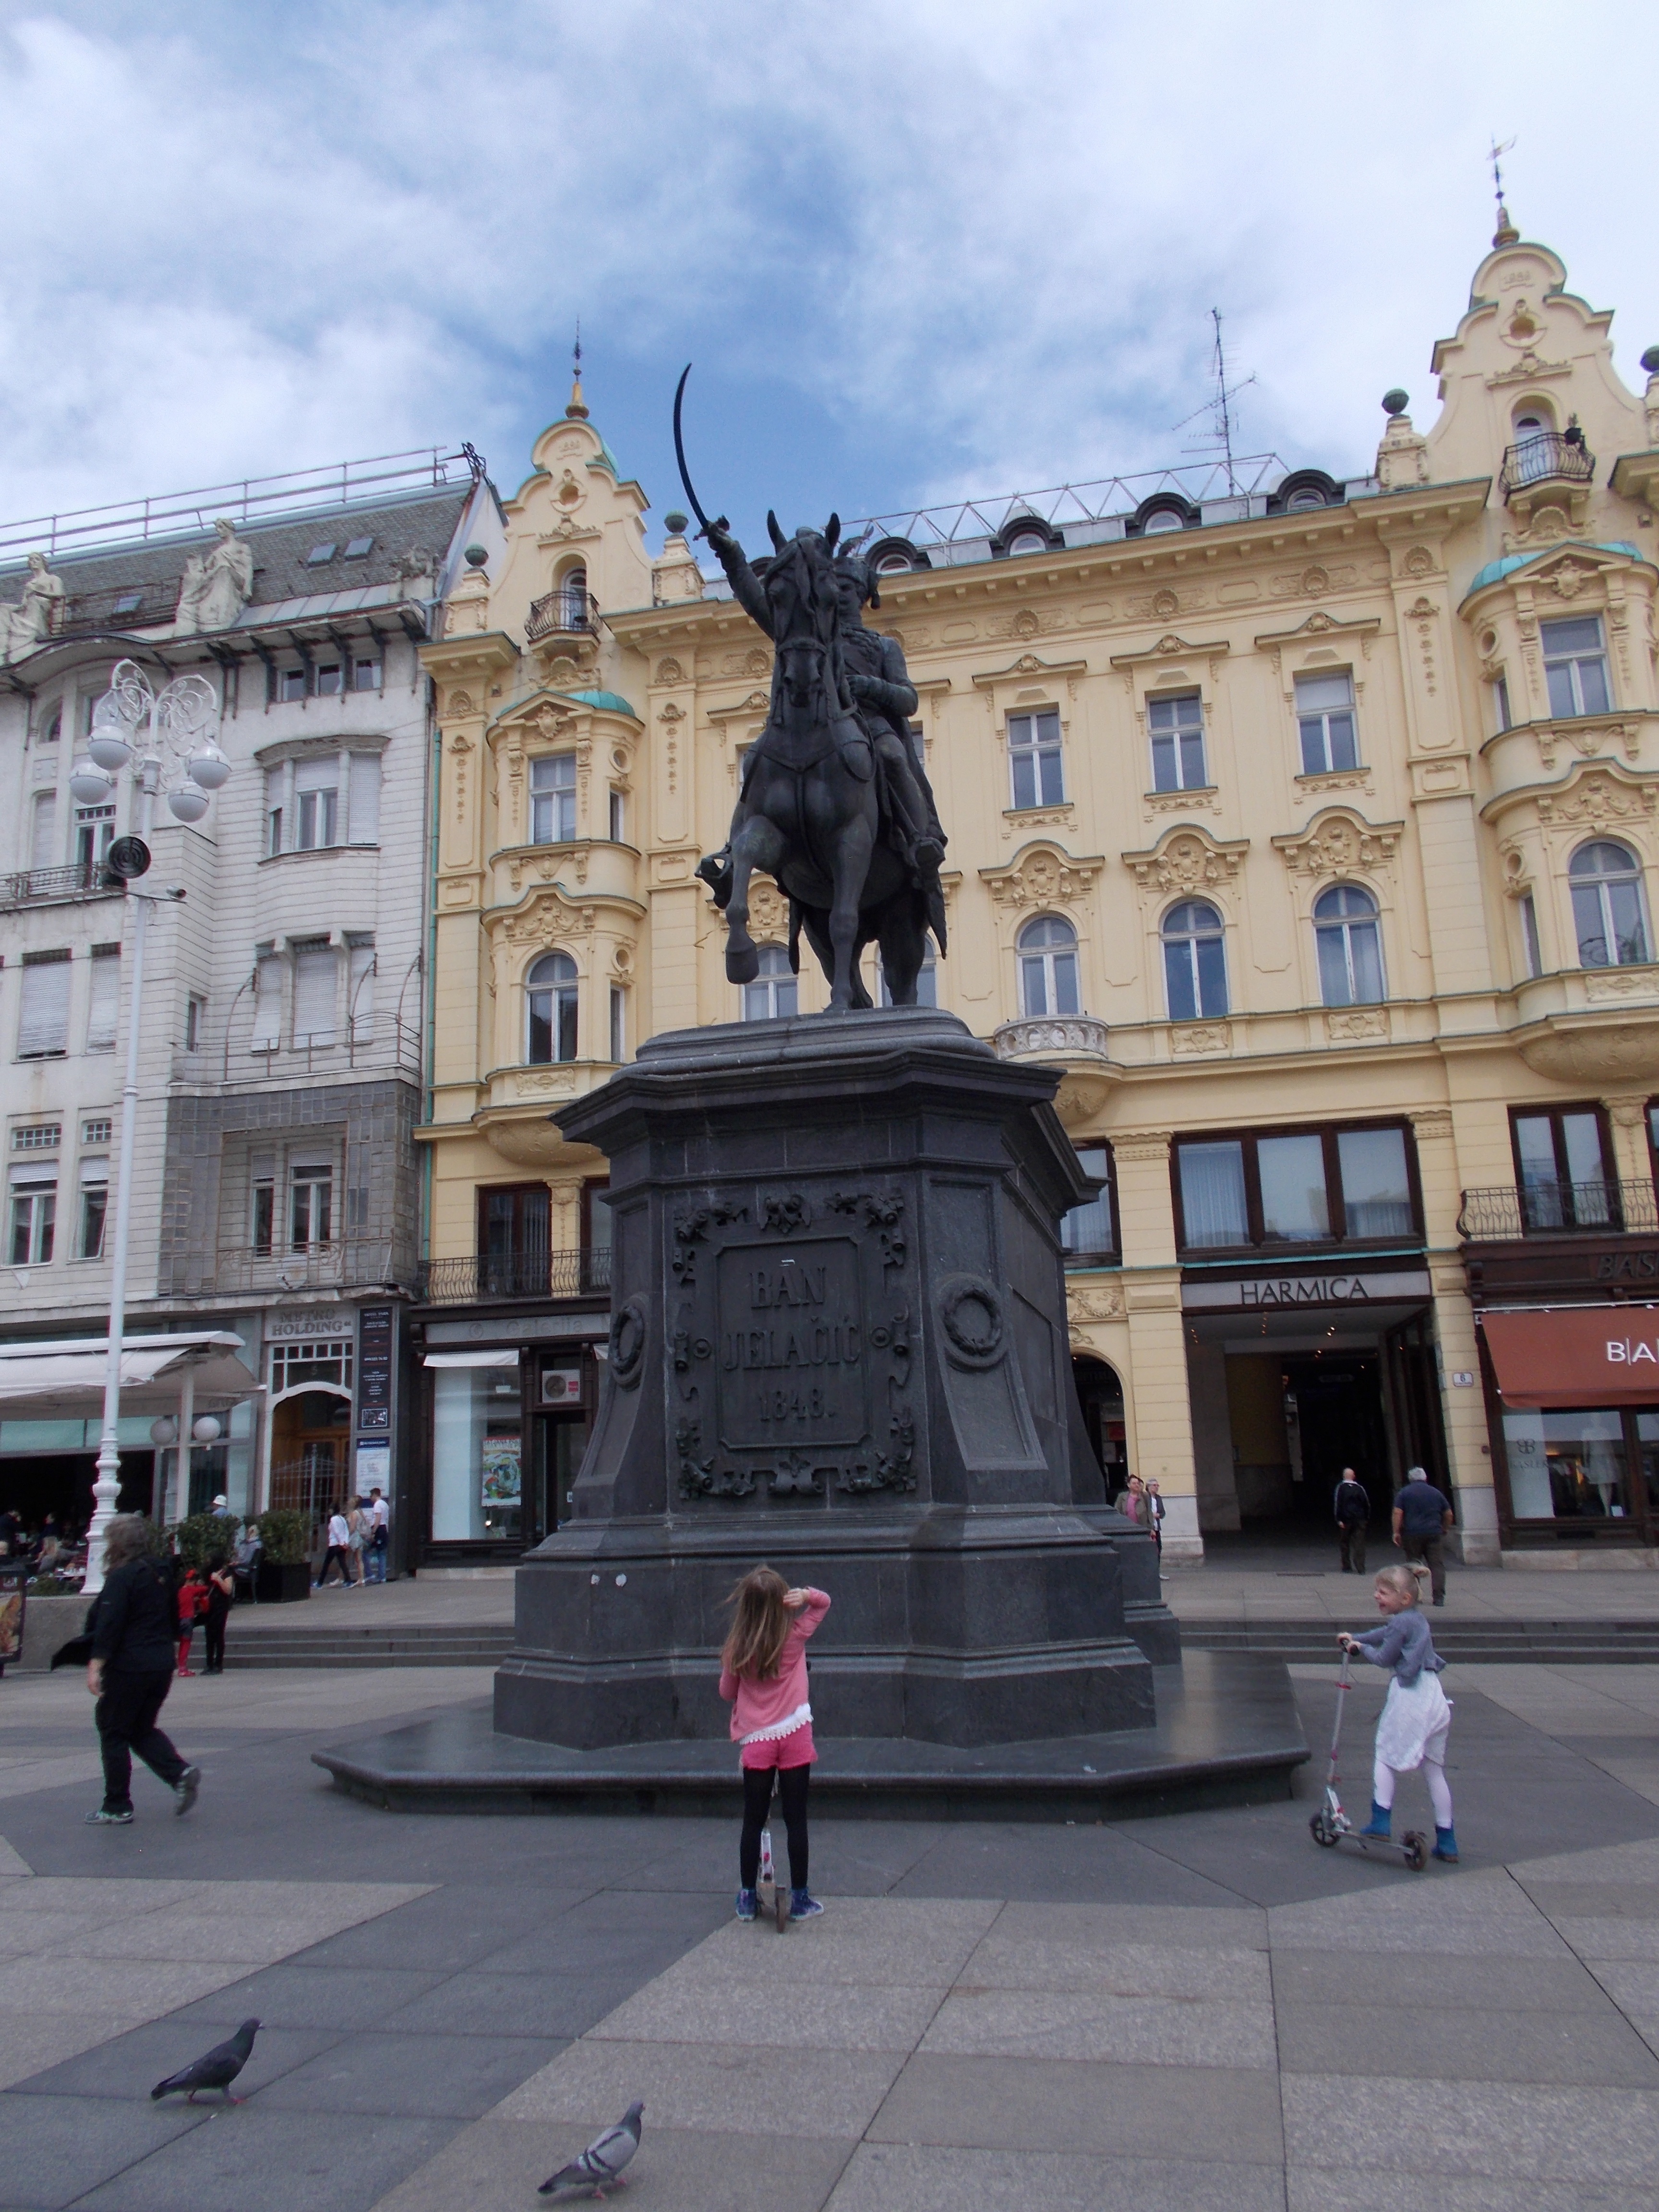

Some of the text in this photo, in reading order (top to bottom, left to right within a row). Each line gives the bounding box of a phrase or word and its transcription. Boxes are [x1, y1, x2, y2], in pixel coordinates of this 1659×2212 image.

[749, 1267, 826, 1309] BAN
[1240, 1277, 1369, 1304] HARMICA
[280, 1309, 335, 1322] METRO
[272, 1321, 343, 1336] HOLDING
[722, 1315, 860, 1371] JELAČIĆ
[1460, 1374, 1466, 1382] 6
